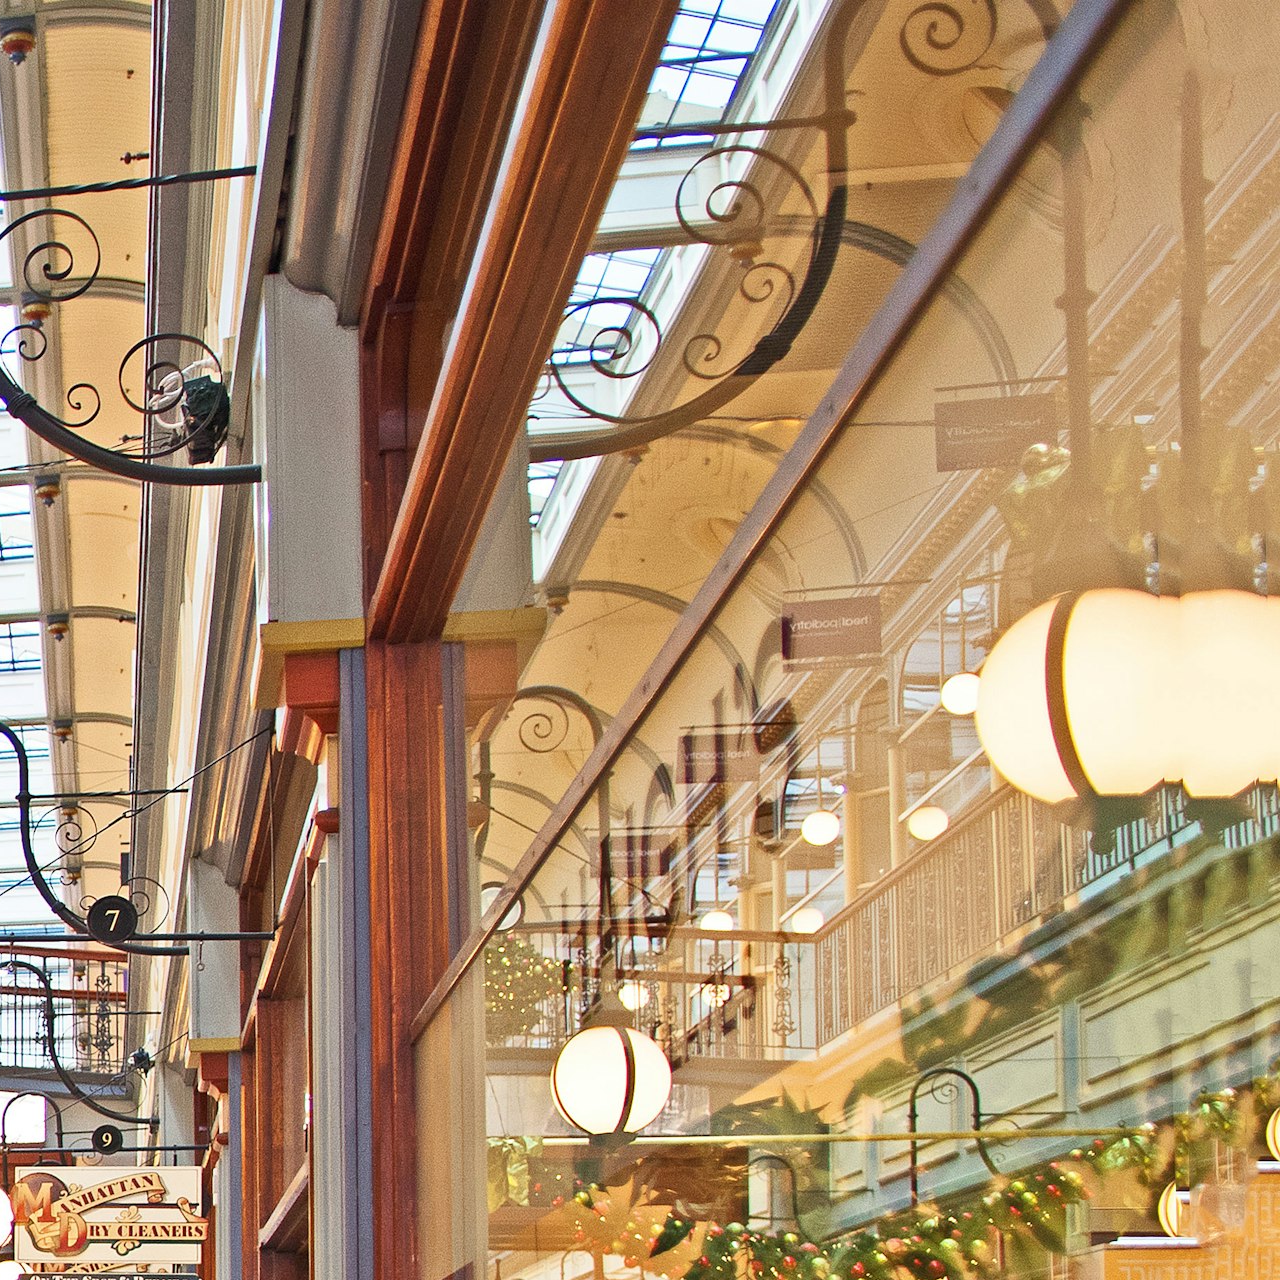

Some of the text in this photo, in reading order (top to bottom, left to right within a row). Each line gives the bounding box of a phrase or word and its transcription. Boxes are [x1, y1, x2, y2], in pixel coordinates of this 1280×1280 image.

[101, 1132, 113, 1147] 9
[14, 1172, 156, 1223] MANHATTAN
[56, 1212, 205, 1253] DRY CLEANERS
